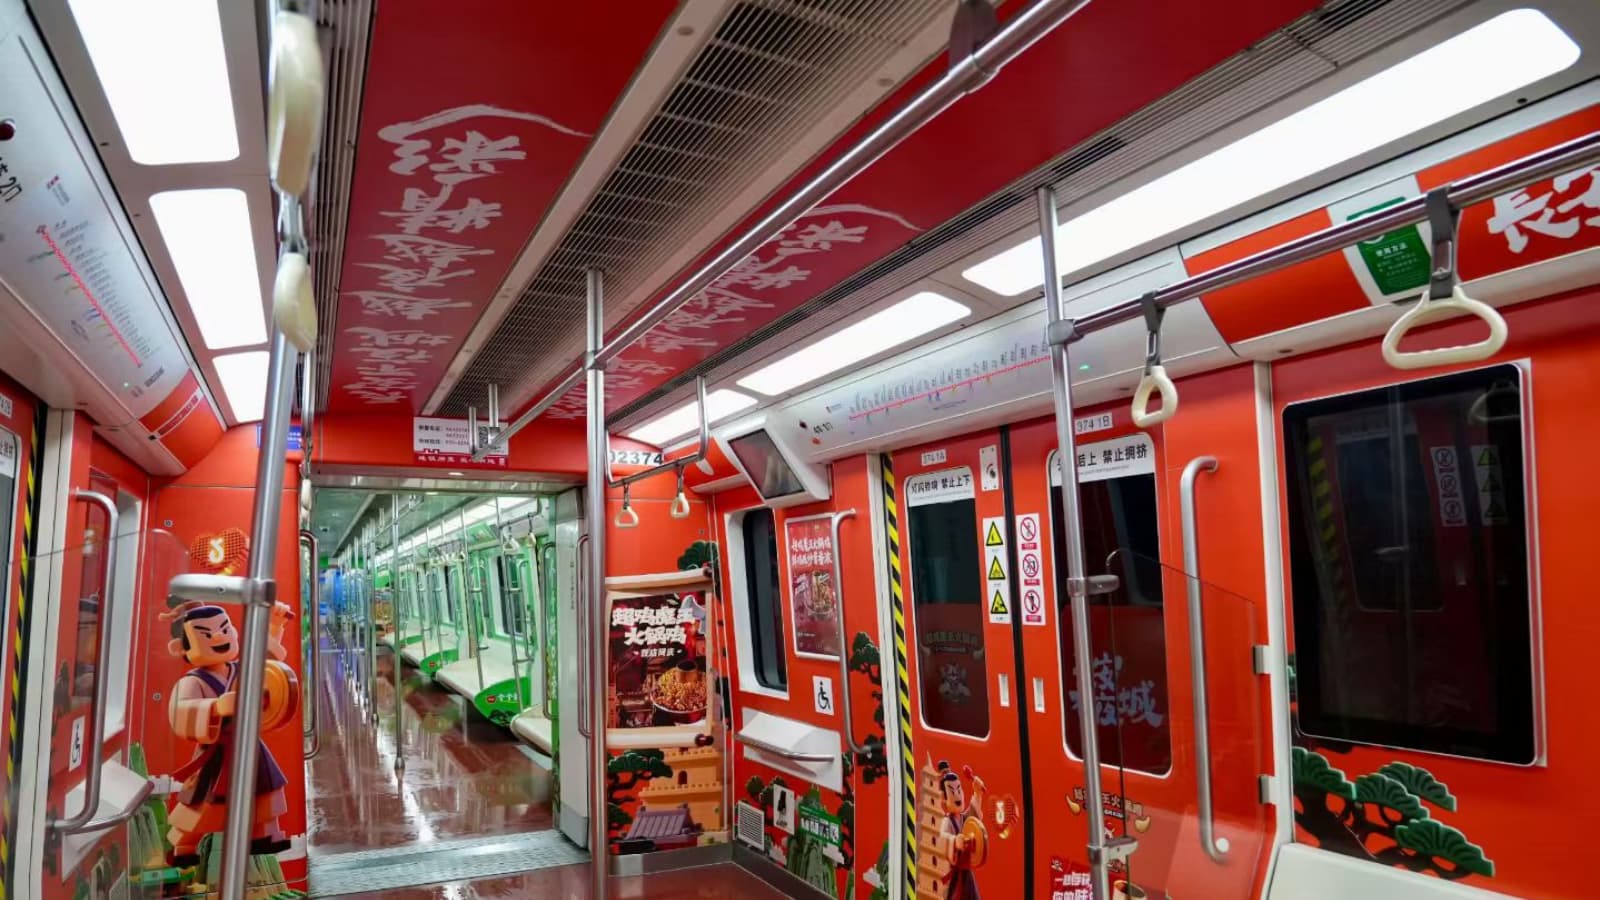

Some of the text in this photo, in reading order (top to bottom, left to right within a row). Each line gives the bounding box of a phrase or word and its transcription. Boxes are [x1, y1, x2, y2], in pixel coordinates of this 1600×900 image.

[1102, 443, 1148, 464] 禁止拥挤
[941, 473, 971, 490] 禁止上下
[612, 606, 697, 626] 超鸡魔王
[624, 625, 687, 646] 火锅鸡
